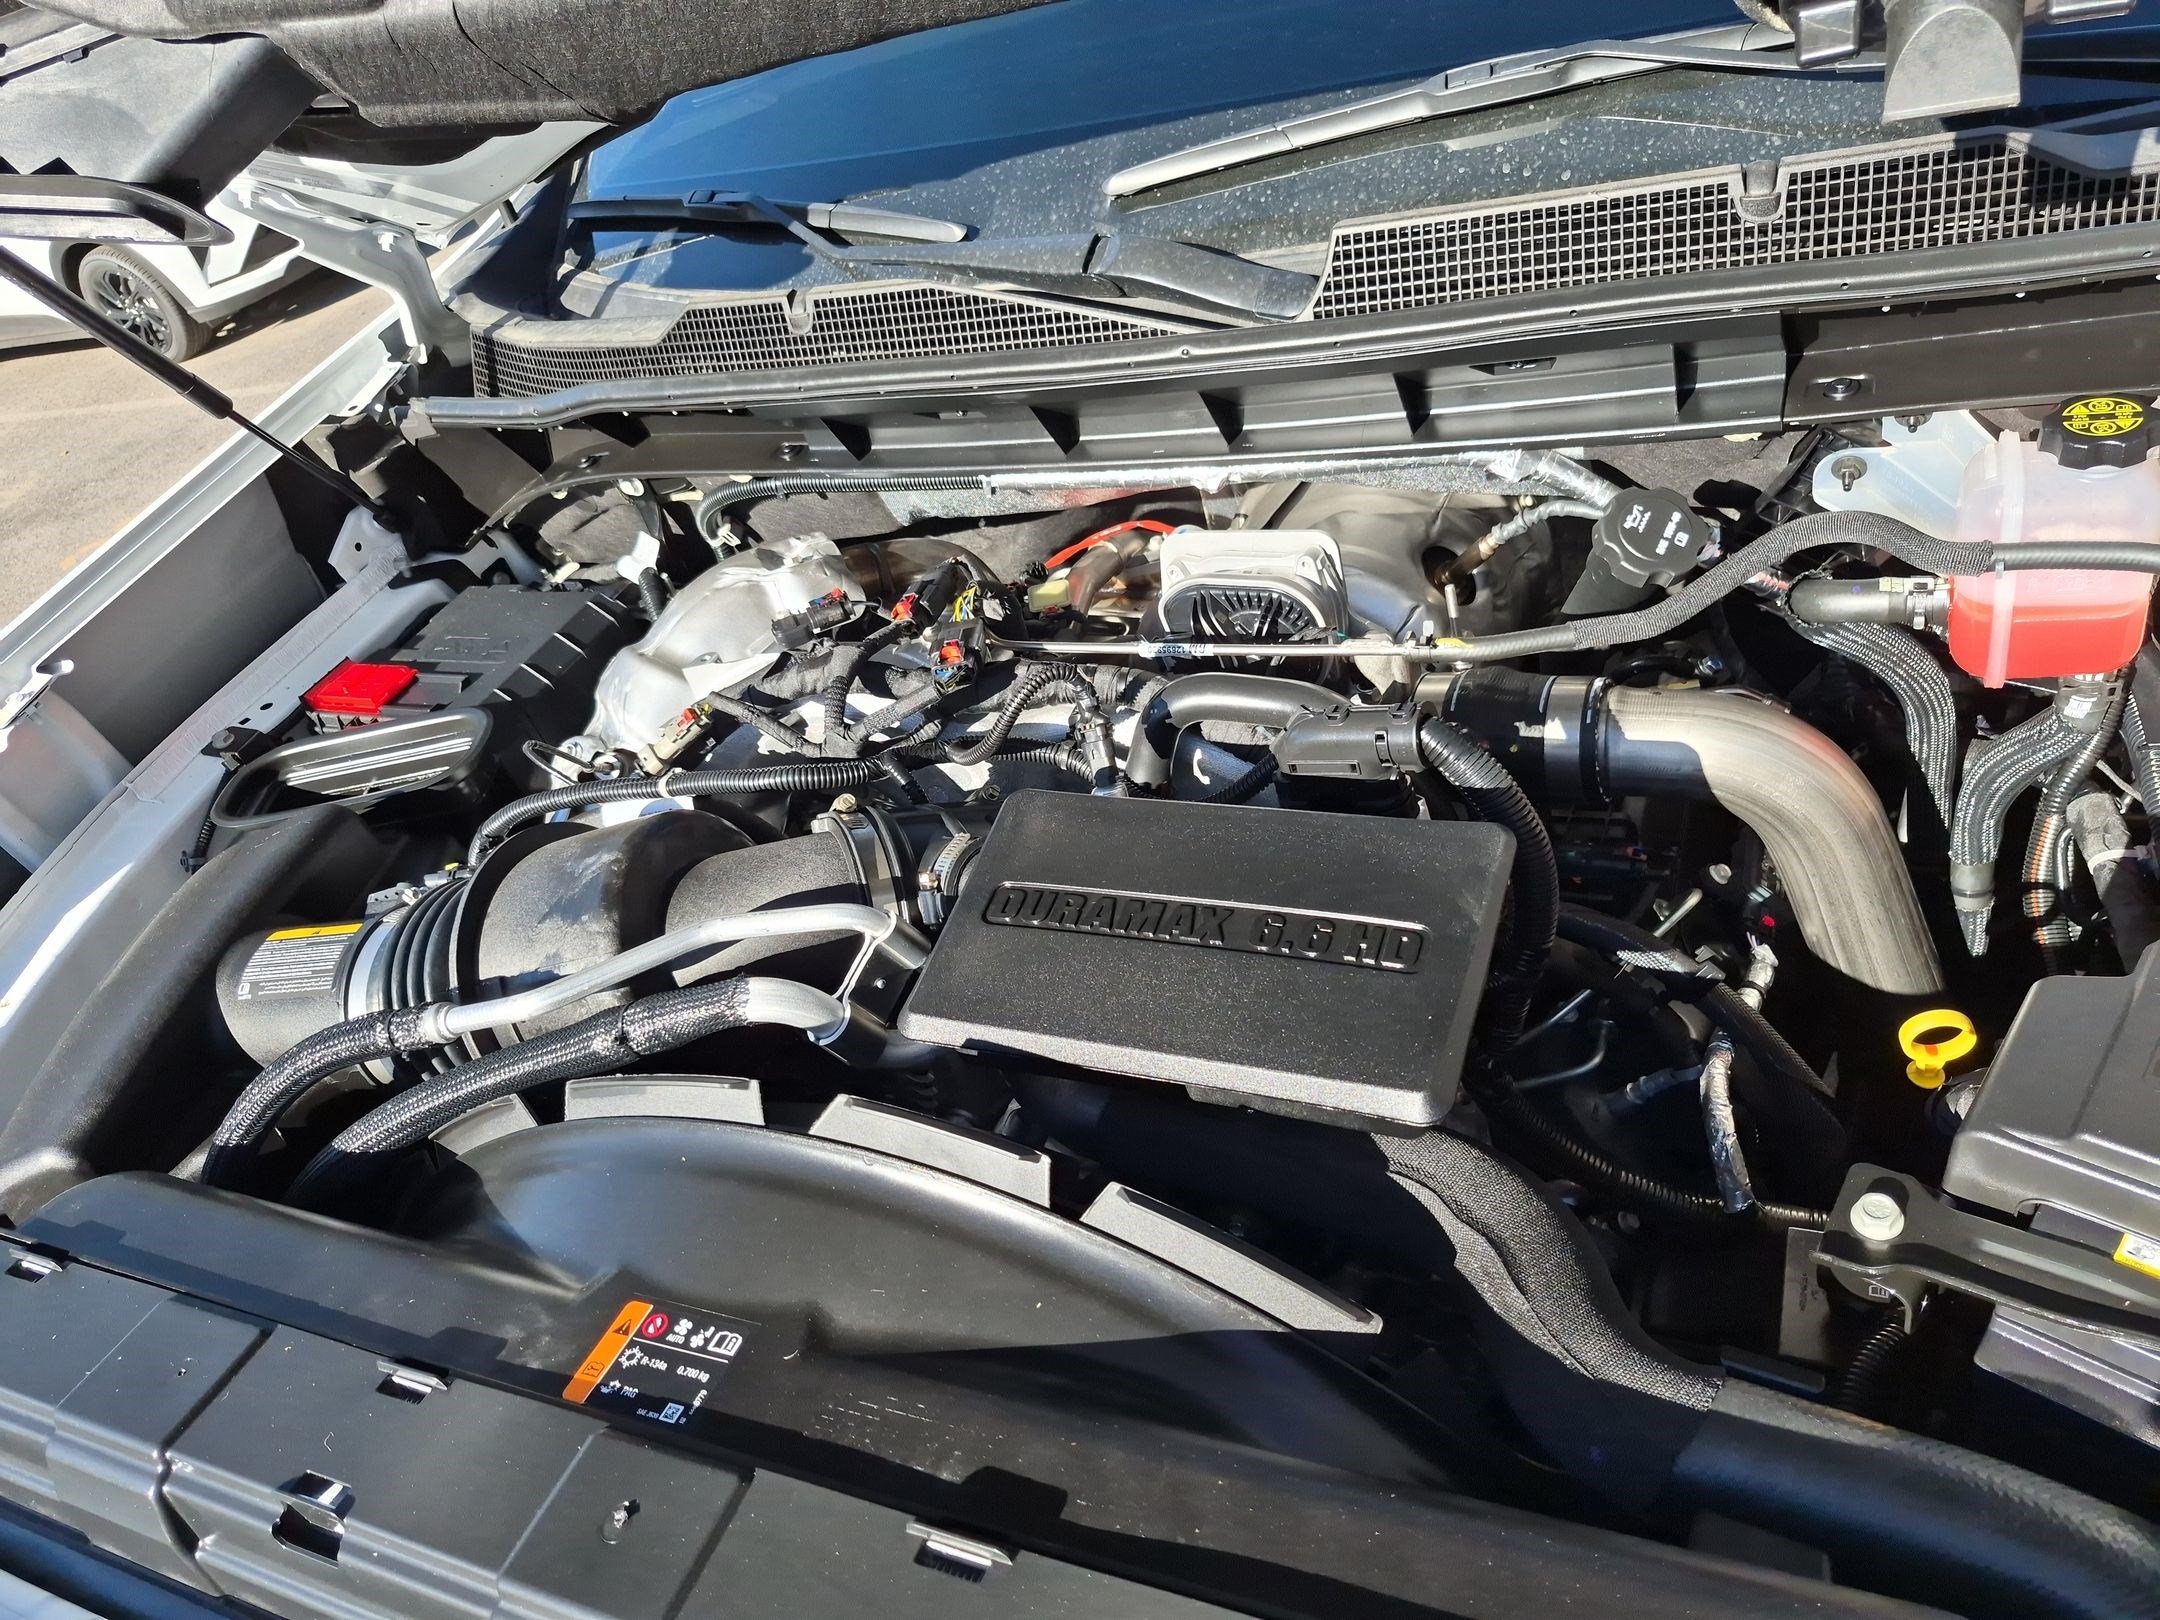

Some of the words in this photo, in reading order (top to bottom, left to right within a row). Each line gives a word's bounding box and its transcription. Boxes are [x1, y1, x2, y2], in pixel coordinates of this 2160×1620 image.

[988, 888, 1234, 946] DURAMAX
[1251, 913, 1336, 958] 6.6
[1344, 923, 1424, 969] HD
[665, 1333, 685, 1345] AUTO
[640, 1356, 668, 1371] R-134a
[677, 1365, 700, 1379] 0.700
[698, 1370, 710, 1383] kg
[620, 1386, 639, 1398] PAG
